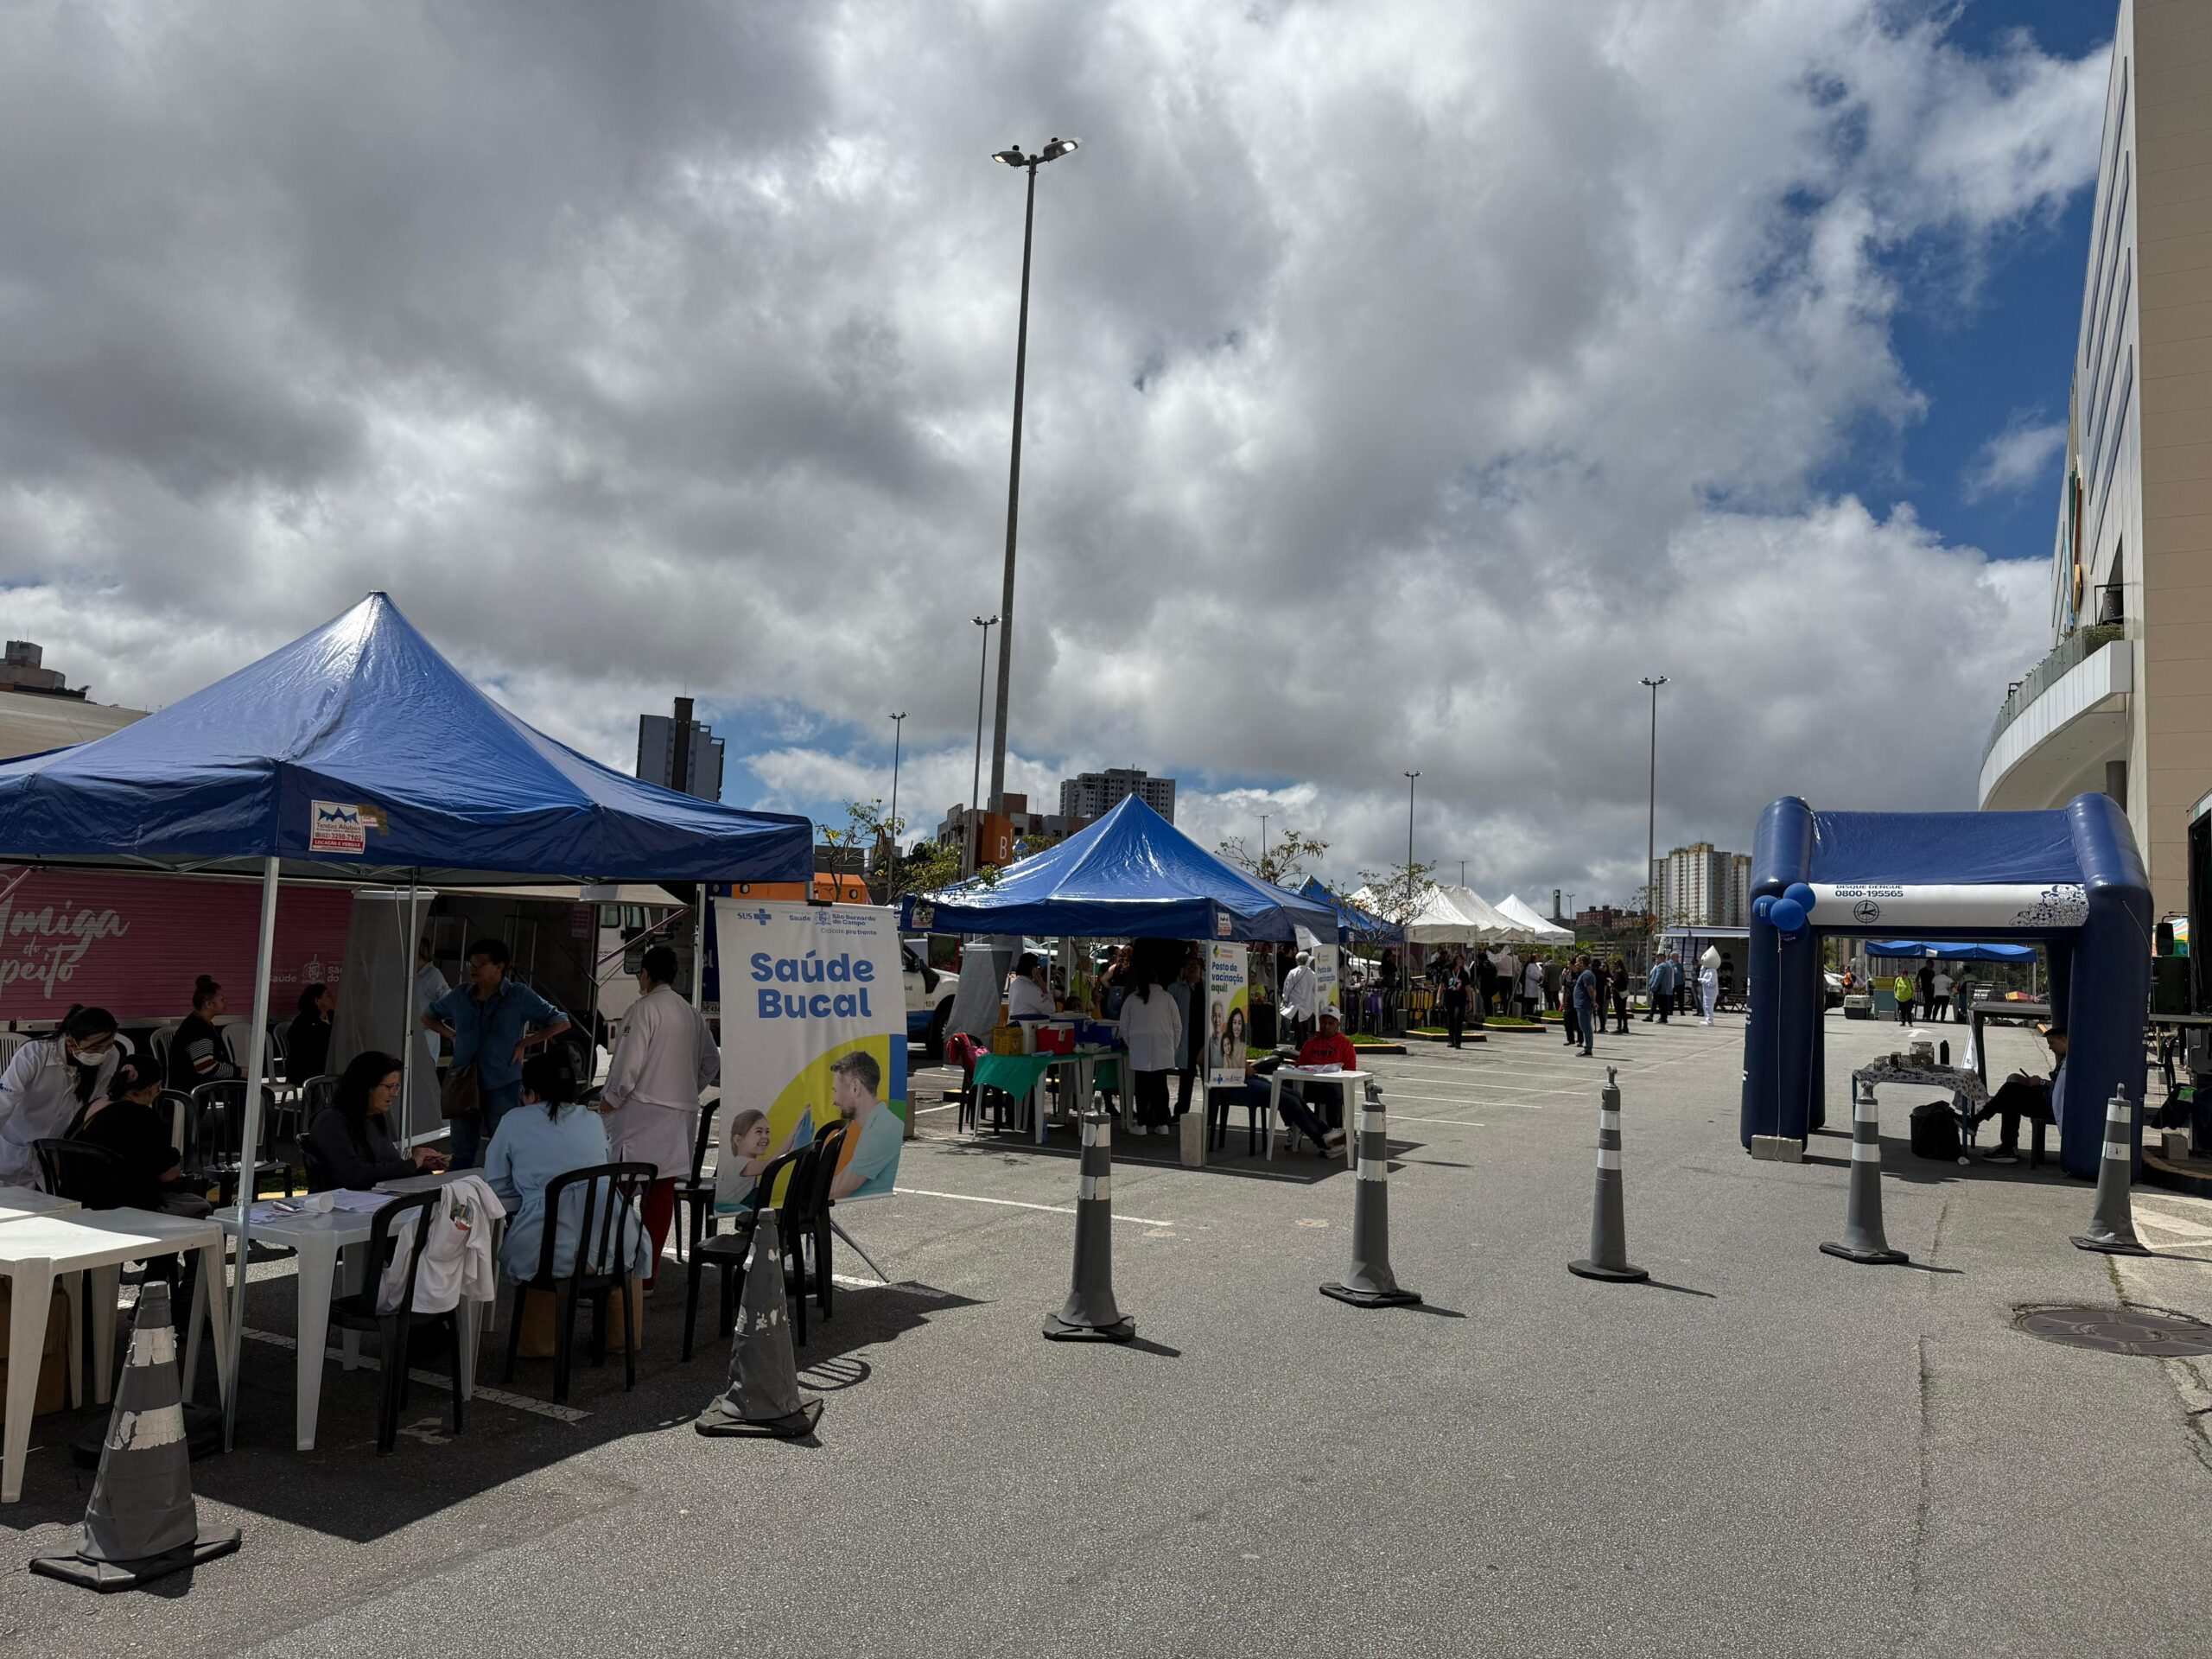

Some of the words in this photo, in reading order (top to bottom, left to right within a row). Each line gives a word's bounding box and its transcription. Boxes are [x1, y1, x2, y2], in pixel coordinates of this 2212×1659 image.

[999, 836, 1007, 860] B
[845, 913, 876, 922] Bernardo
[23, 935, 42, 957] do
[750, 950, 875, 983] Saúde
[1211, 962, 1229, 971] Posto
[1230, 963, 1238, 972] de
[327, 974, 340, 982] do
[1211, 972, 1243, 985] vacinação
[758, 987, 873, 1019] Bucal
